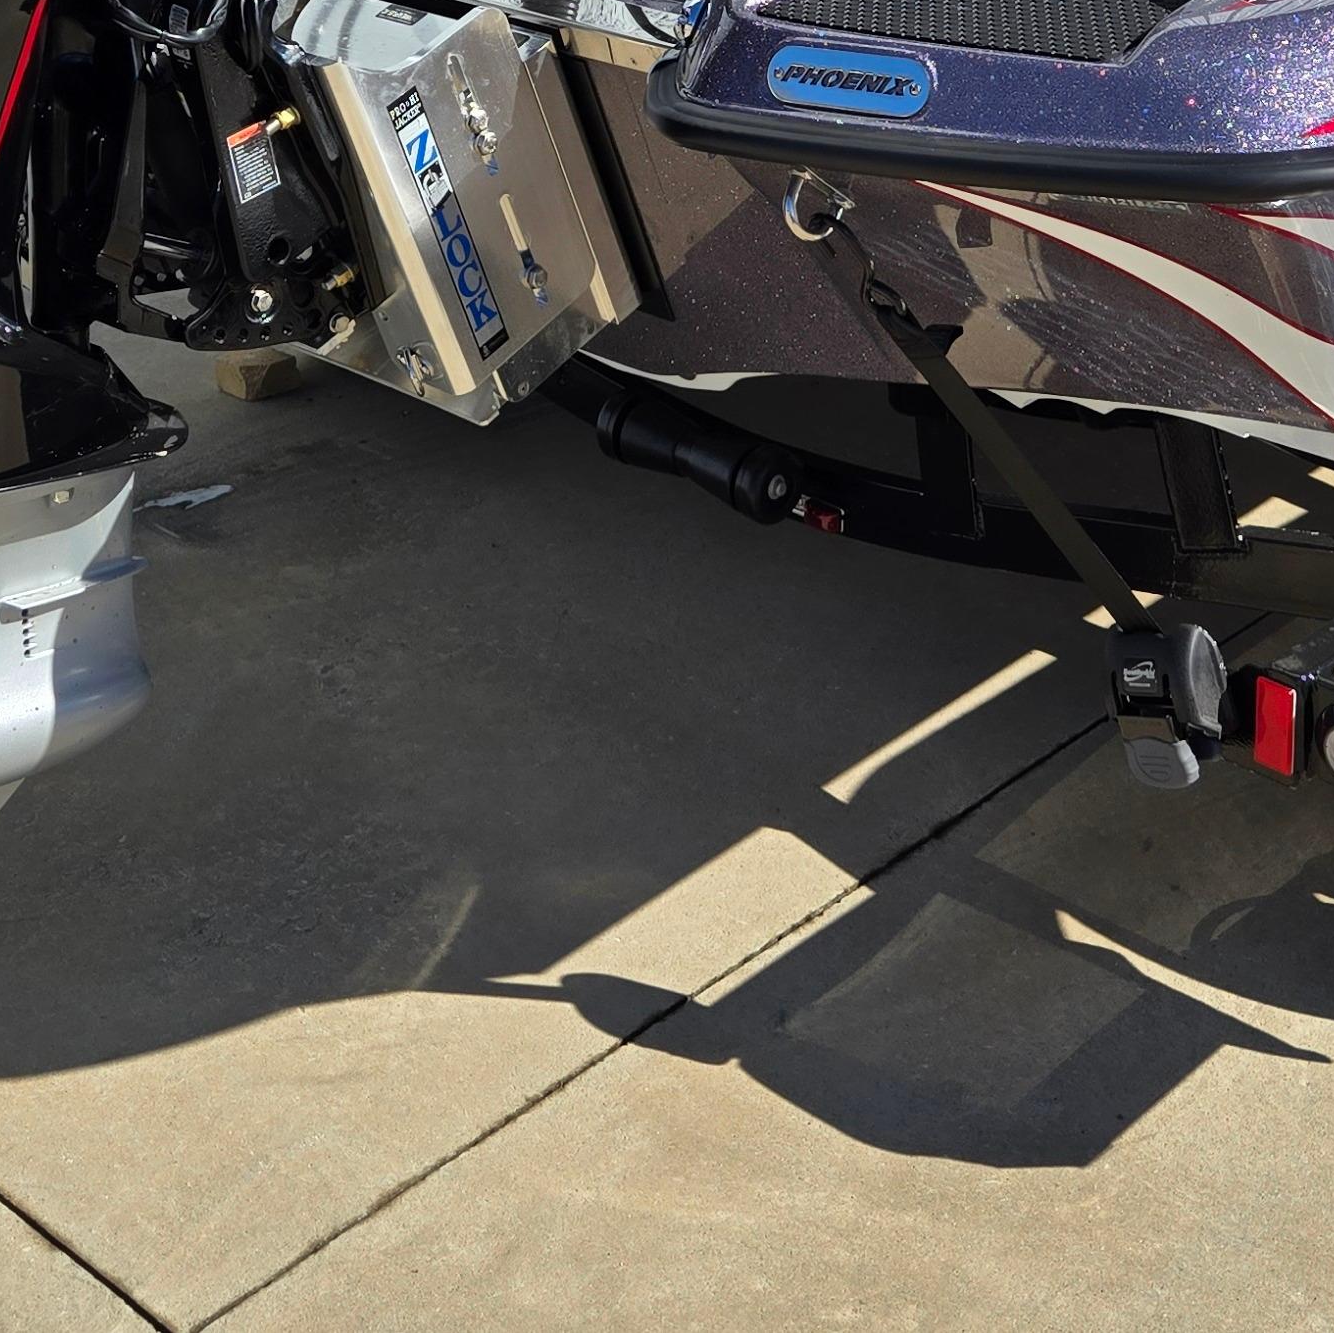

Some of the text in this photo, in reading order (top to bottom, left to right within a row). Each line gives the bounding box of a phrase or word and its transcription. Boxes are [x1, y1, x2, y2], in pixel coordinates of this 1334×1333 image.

[781, 64, 912, 97] PHOENIX
[406, 129, 438, 174] Z
[431, 206, 498, 333] LOCK
